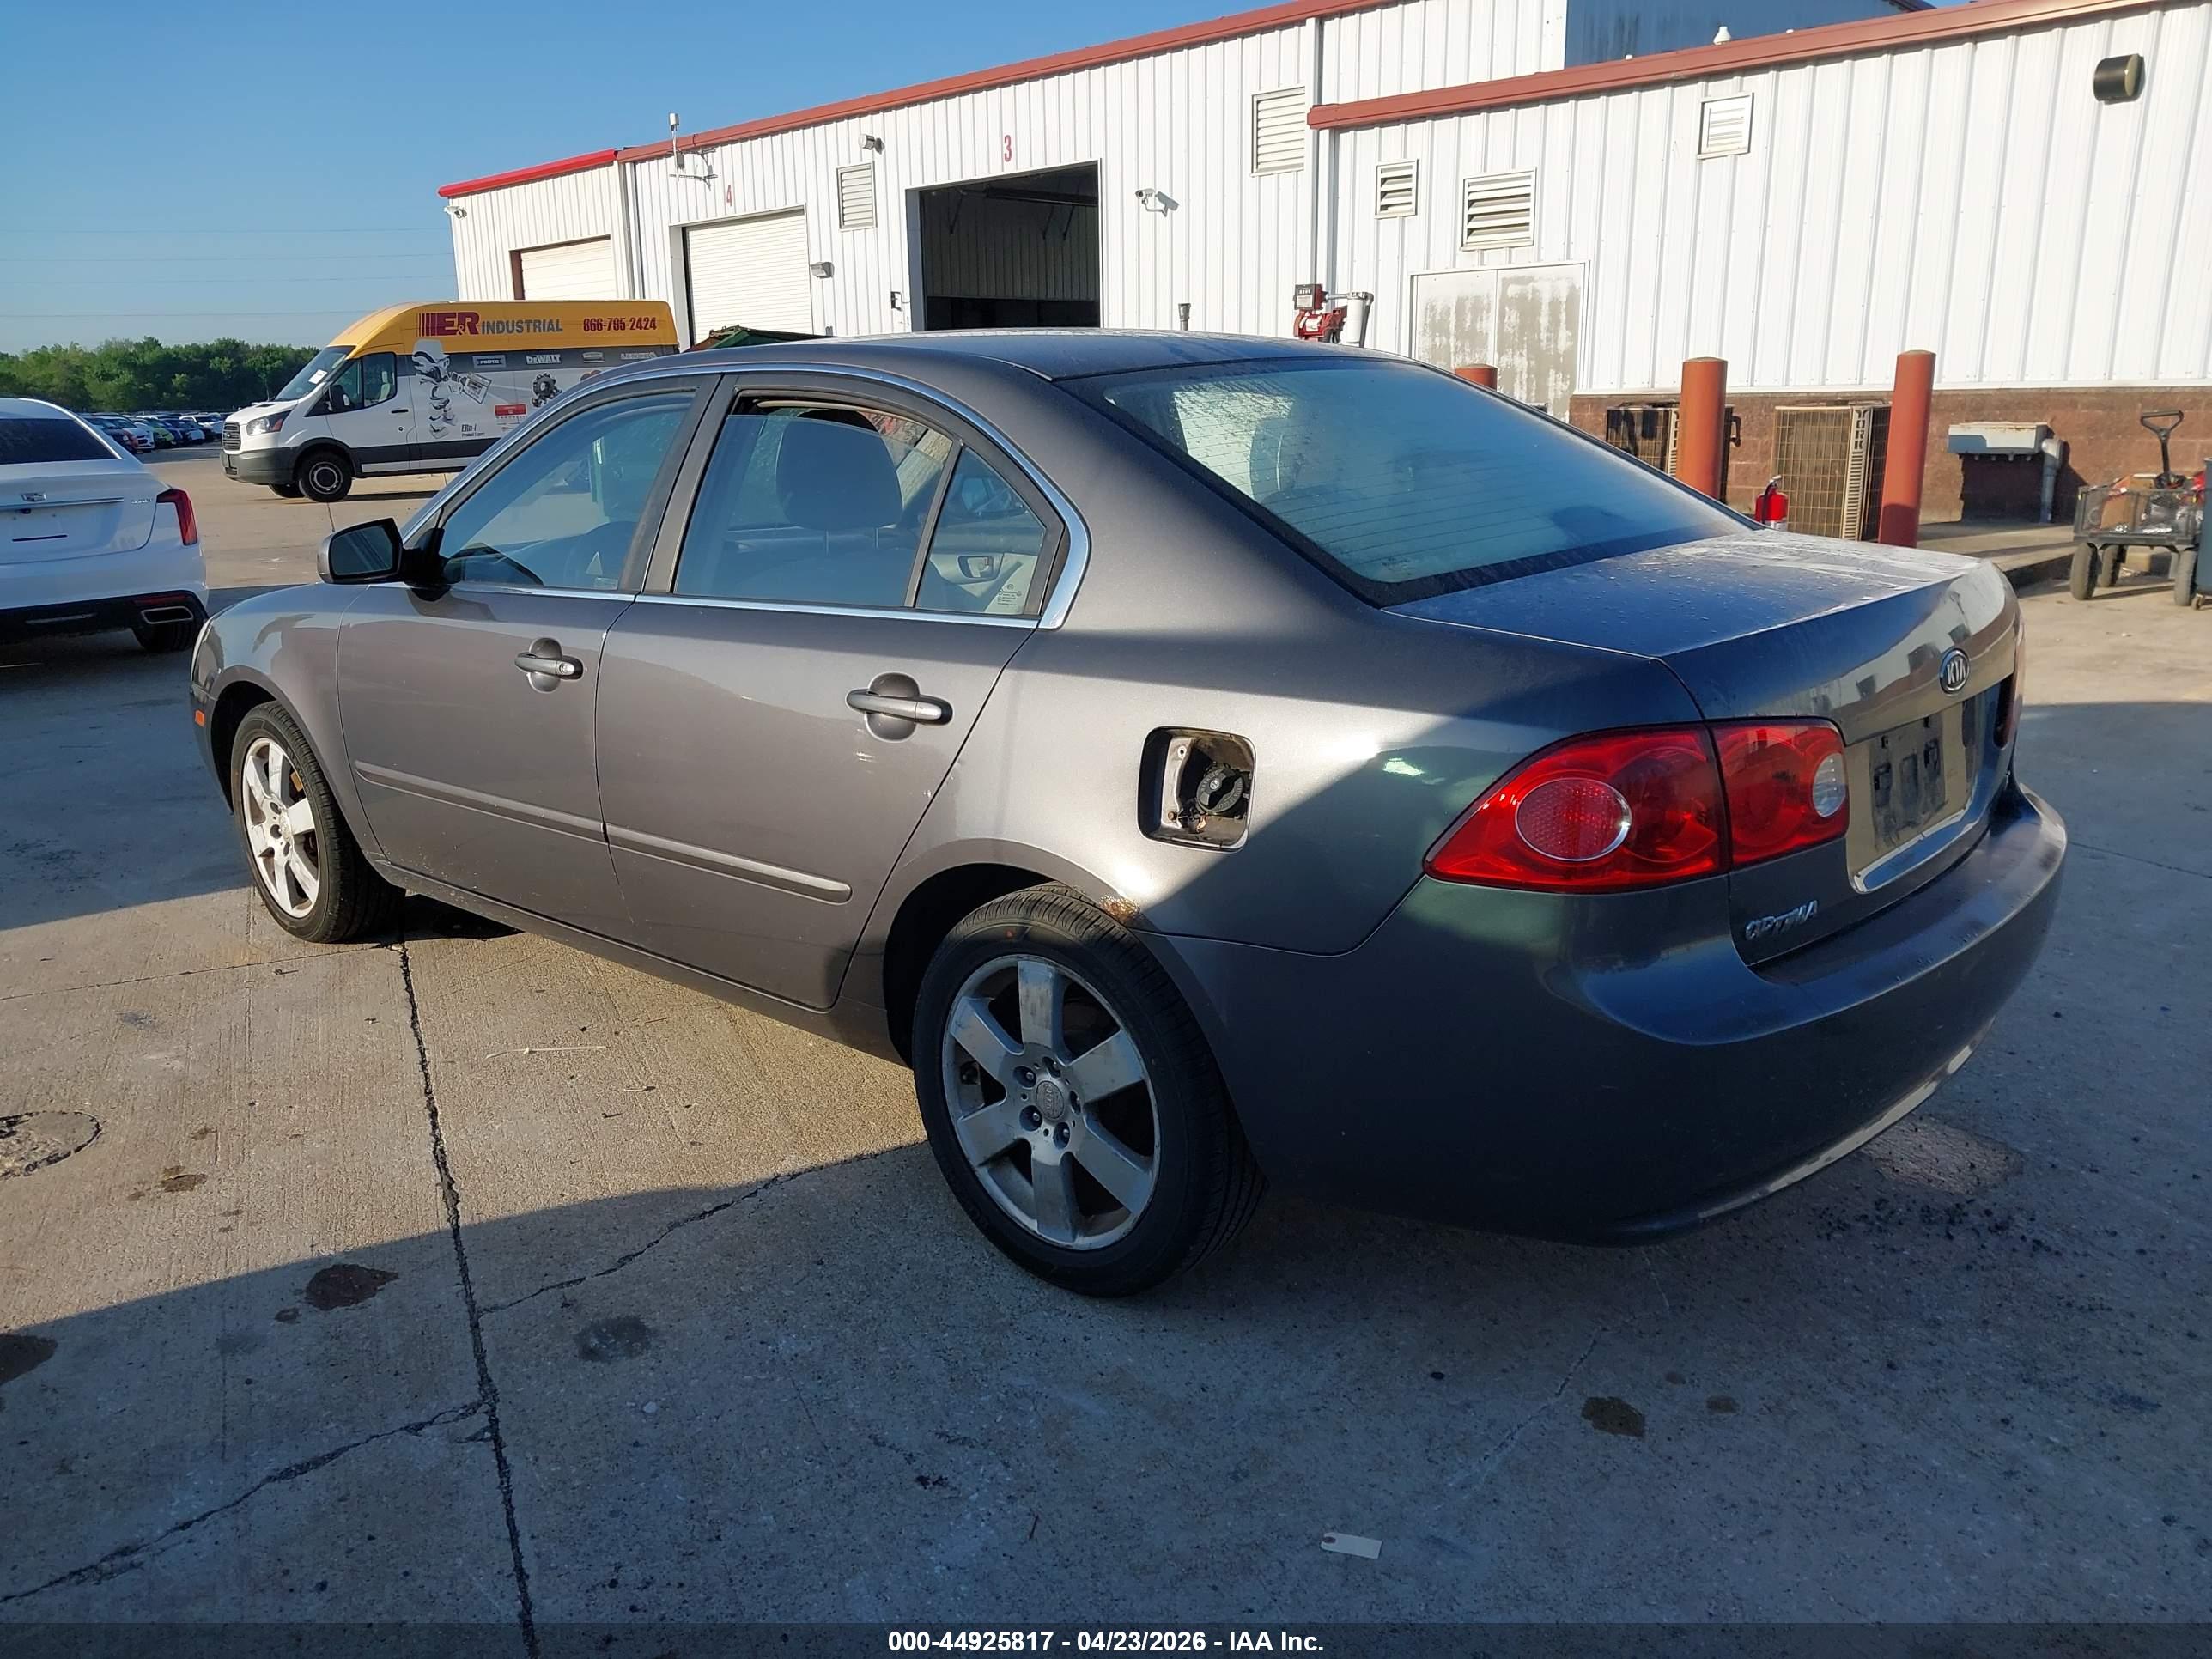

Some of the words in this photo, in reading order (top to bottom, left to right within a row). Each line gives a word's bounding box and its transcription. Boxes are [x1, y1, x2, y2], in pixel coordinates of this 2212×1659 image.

[1004, 134, 1012, 162] 3
[726, 185, 732, 207] 4
[481, 319, 563, 335] INDUSTRIAL
[583, 316, 657, 332] 866-795-2424
[1854, 409, 1869, 450] YORK
[1947, 659, 1966, 685] KIA
[1745, 900, 1818, 940] OPTIMA
